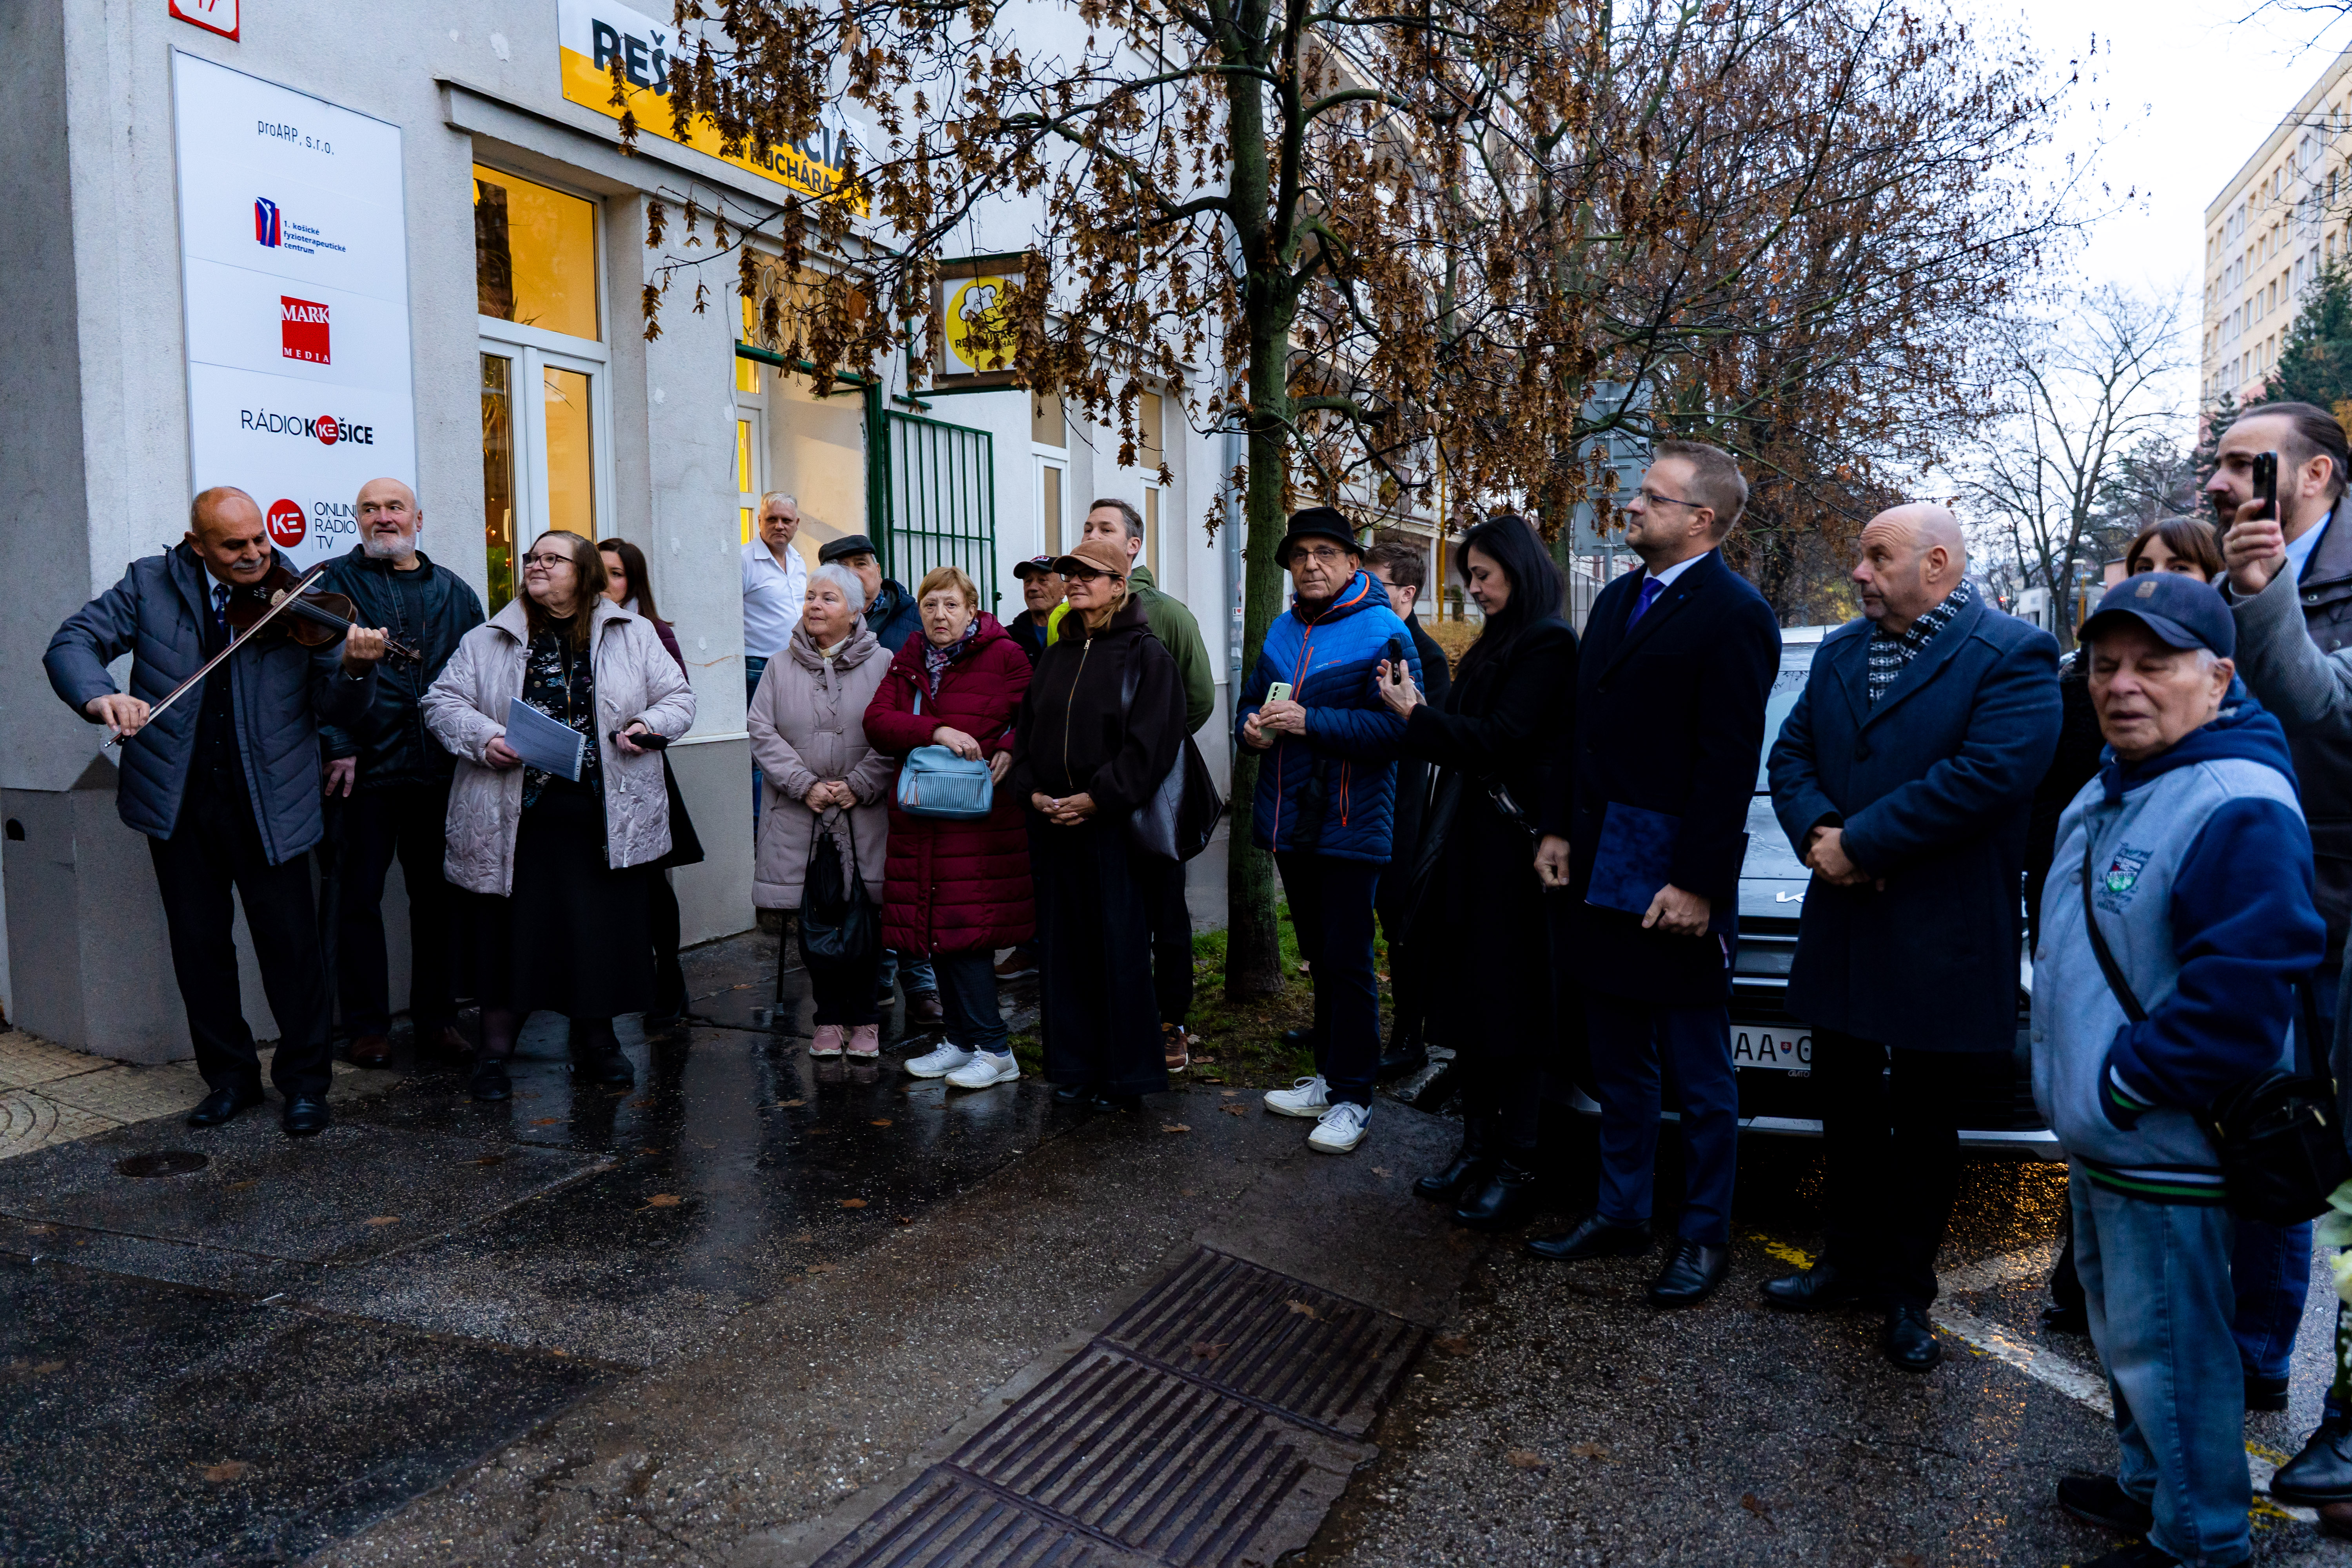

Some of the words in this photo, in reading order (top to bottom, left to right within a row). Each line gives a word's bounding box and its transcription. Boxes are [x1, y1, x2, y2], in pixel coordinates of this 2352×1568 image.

[306, 136, 334, 155] s.r.o.
[293, 223, 320, 235] košické
[284, 230, 346, 252] fyzioterapeutické
[284, 243, 314, 254] centrum
[281, 304, 330, 324] MARK
[284, 347, 329, 363] MEDIA
[241, 408, 302, 436] RÁDIO
[271, 512, 302, 535] KE
[315, 516, 356, 534] RÁDIO
[316, 535, 334, 549] TV
